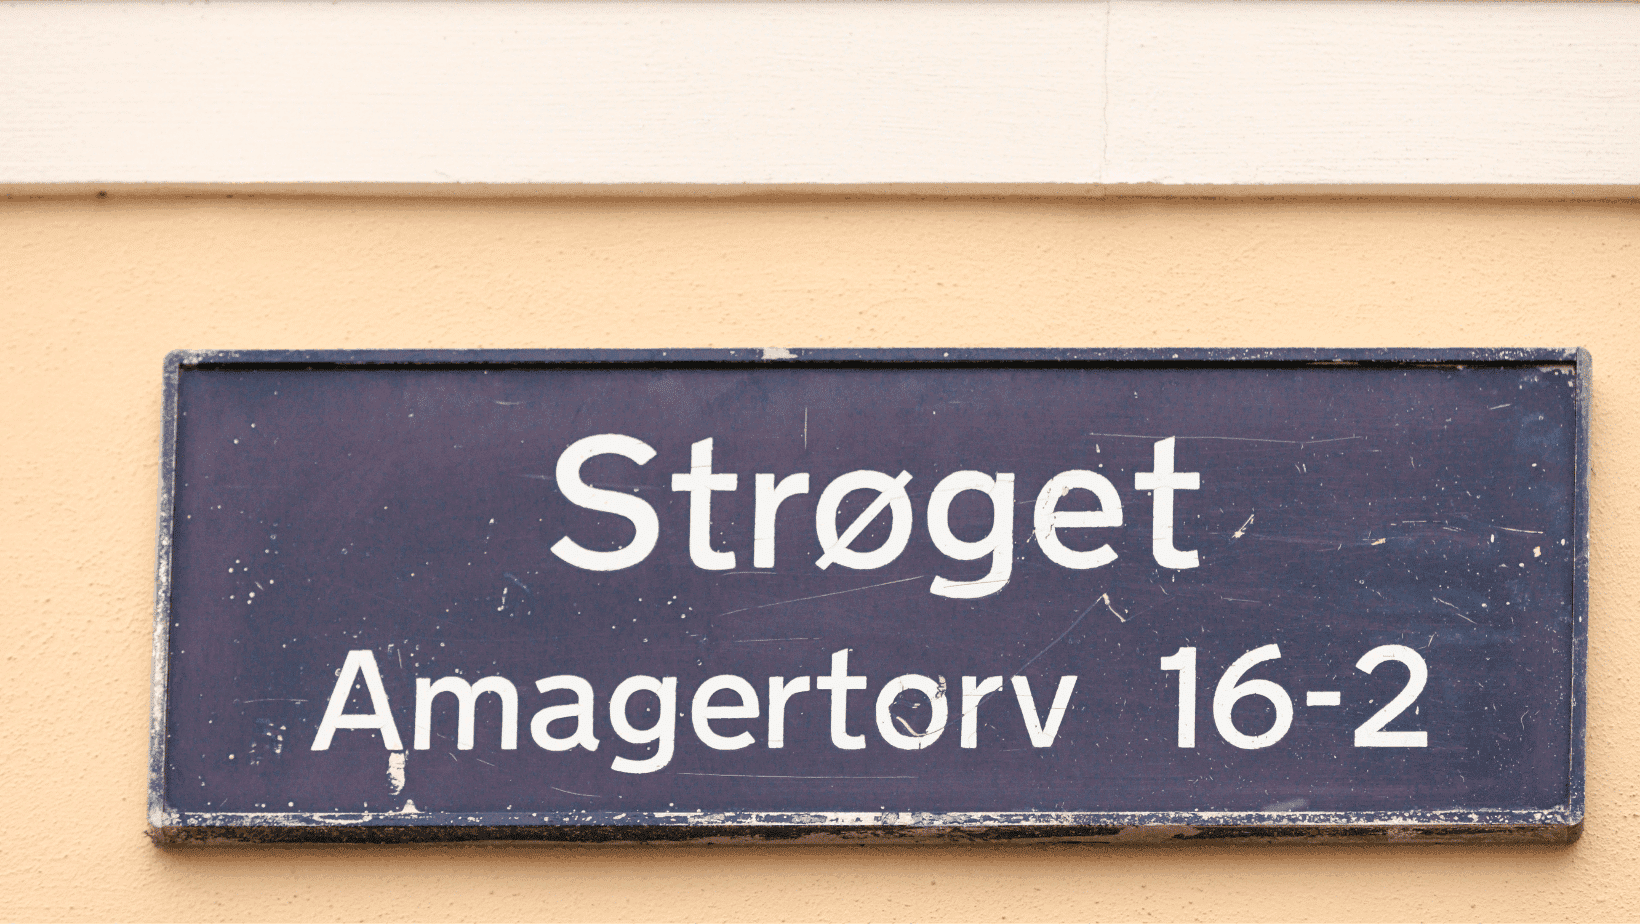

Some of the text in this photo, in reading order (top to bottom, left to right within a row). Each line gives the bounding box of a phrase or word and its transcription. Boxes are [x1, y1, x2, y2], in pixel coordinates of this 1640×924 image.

[550, 433, 1200, 599] Strøget
[310, 643, 1428, 774] Amagertorv 16-2
